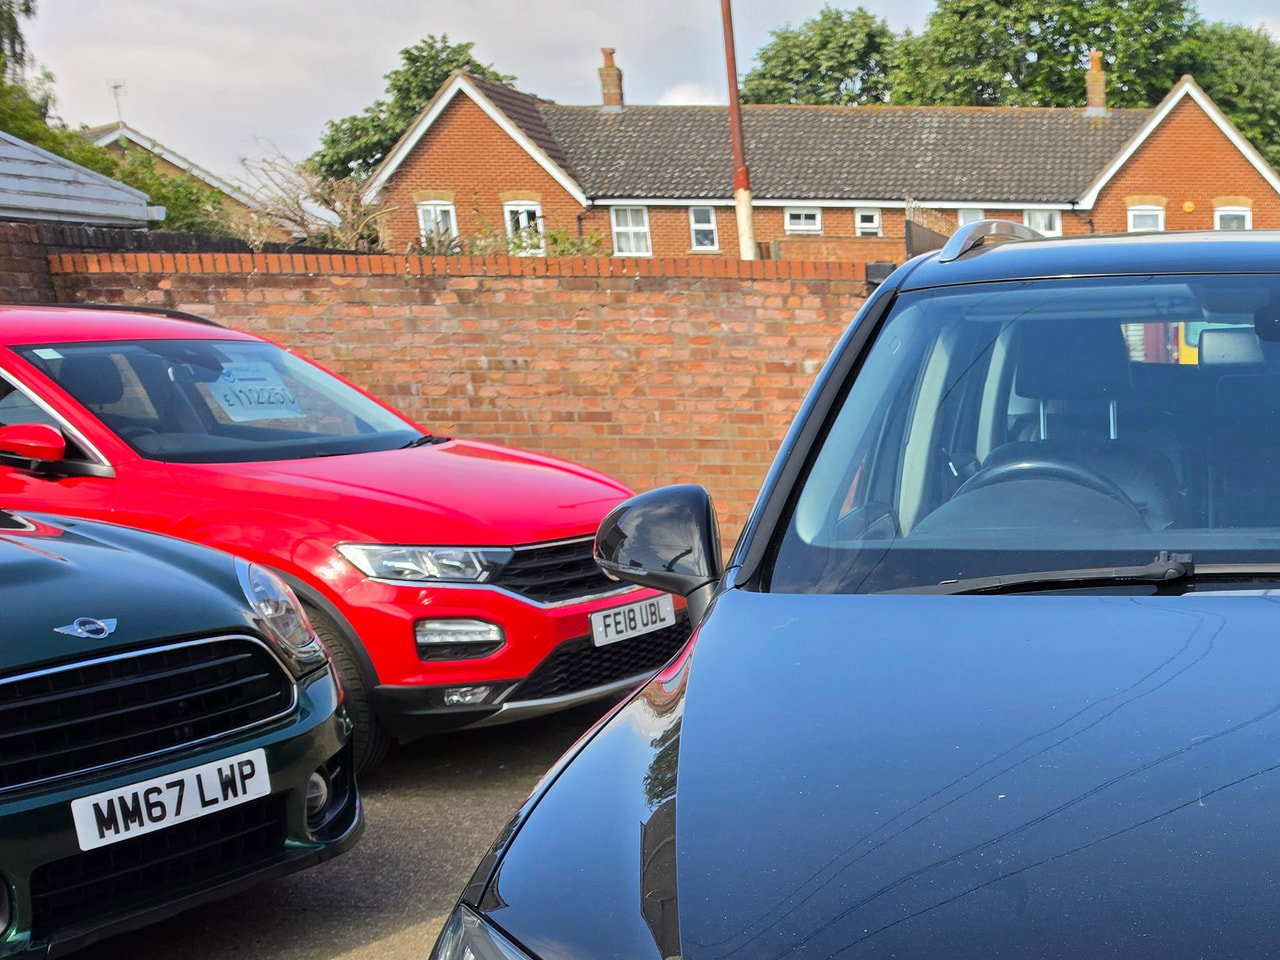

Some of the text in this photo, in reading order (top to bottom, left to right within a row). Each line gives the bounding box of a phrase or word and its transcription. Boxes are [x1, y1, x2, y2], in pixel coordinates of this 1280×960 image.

[602, 600, 666, 638] FE18 UBL
[92, 758, 256, 840] MM67 LWP
